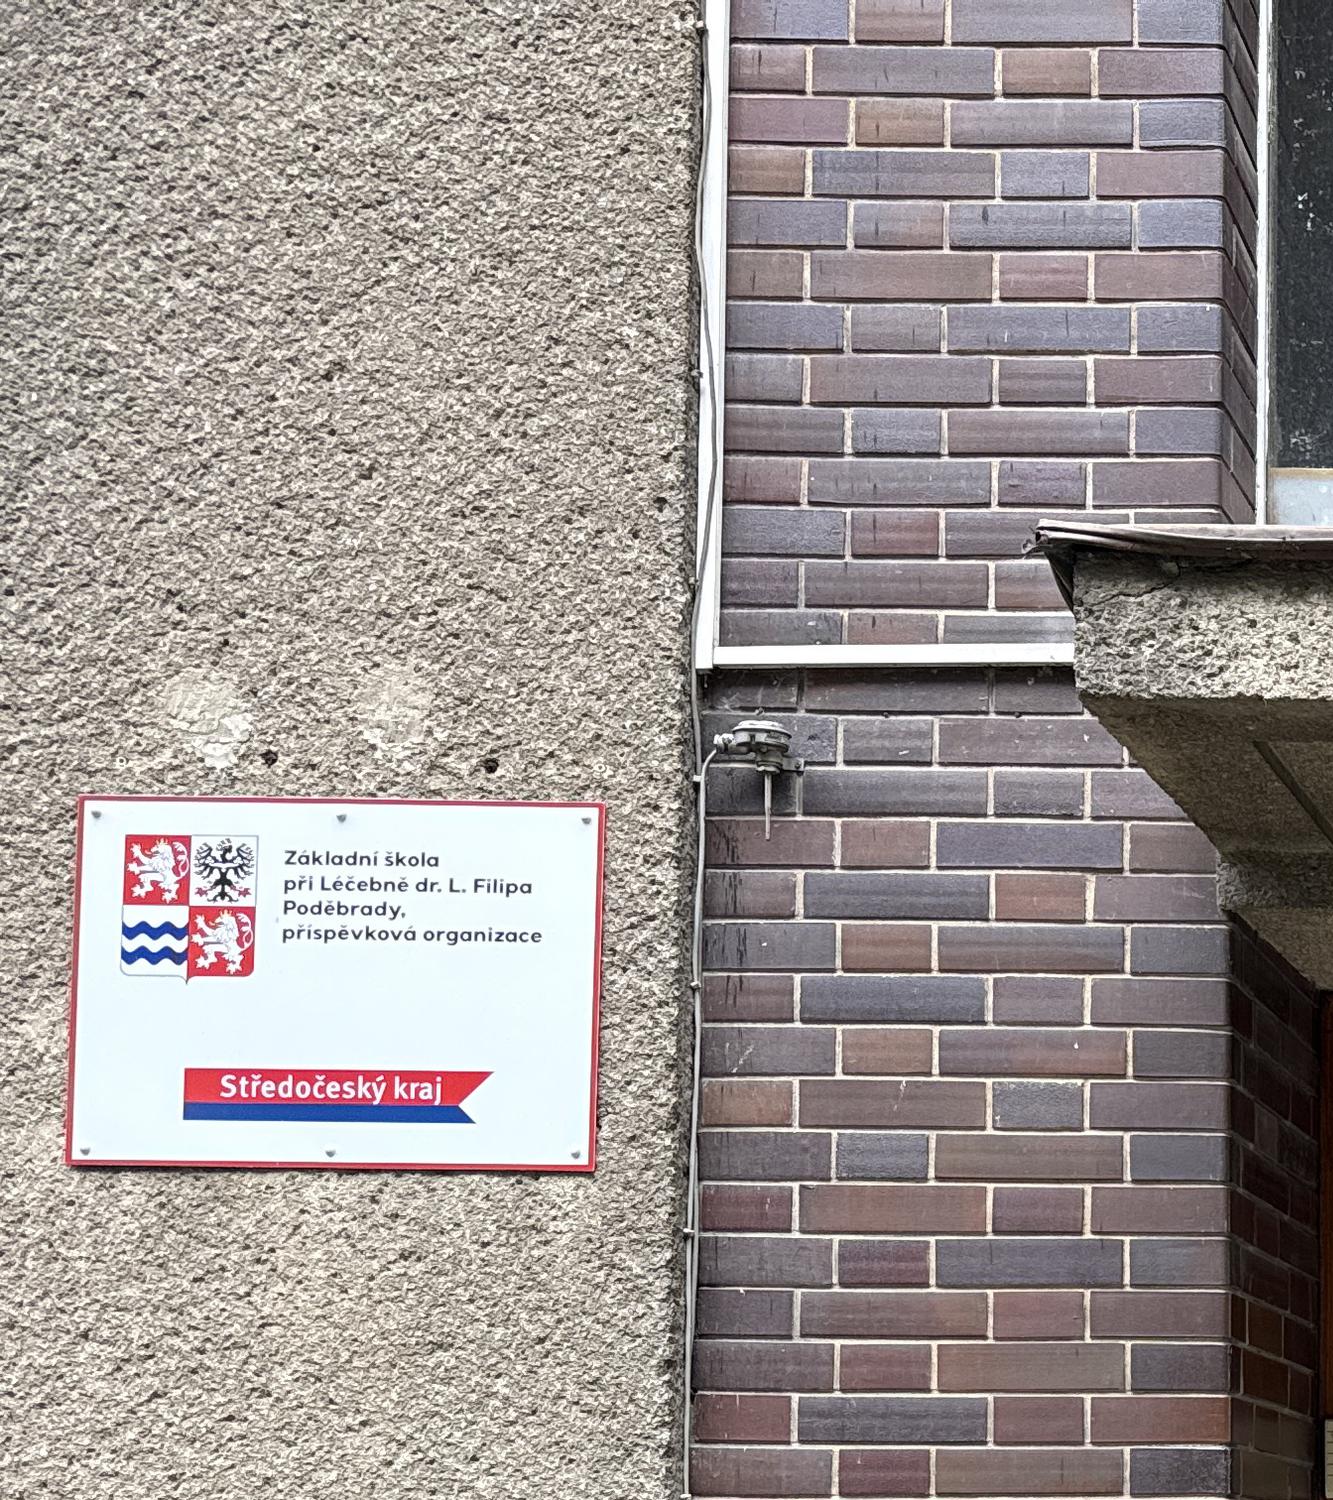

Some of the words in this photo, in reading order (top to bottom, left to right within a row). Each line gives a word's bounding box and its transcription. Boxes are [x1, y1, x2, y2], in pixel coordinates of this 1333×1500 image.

[283, 848, 379, 868] Základní
[384, 849, 440, 868] škola
[282, 876, 315, 895] při
[320, 874, 410, 894] Léčebně
[414, 876, 443, 894] dr.
[448, 878, 467, 894] L.
[473, 876, 533, 898] Filipa
[282, 899, 407, 922] Poděbrady,
[281, 924, 417, 945] příspěvková
[422, 926, 543, 948] organizace
[219, 1074, 387, 1106] Středočeský
[393, 1074, 442, 1106] kraj
